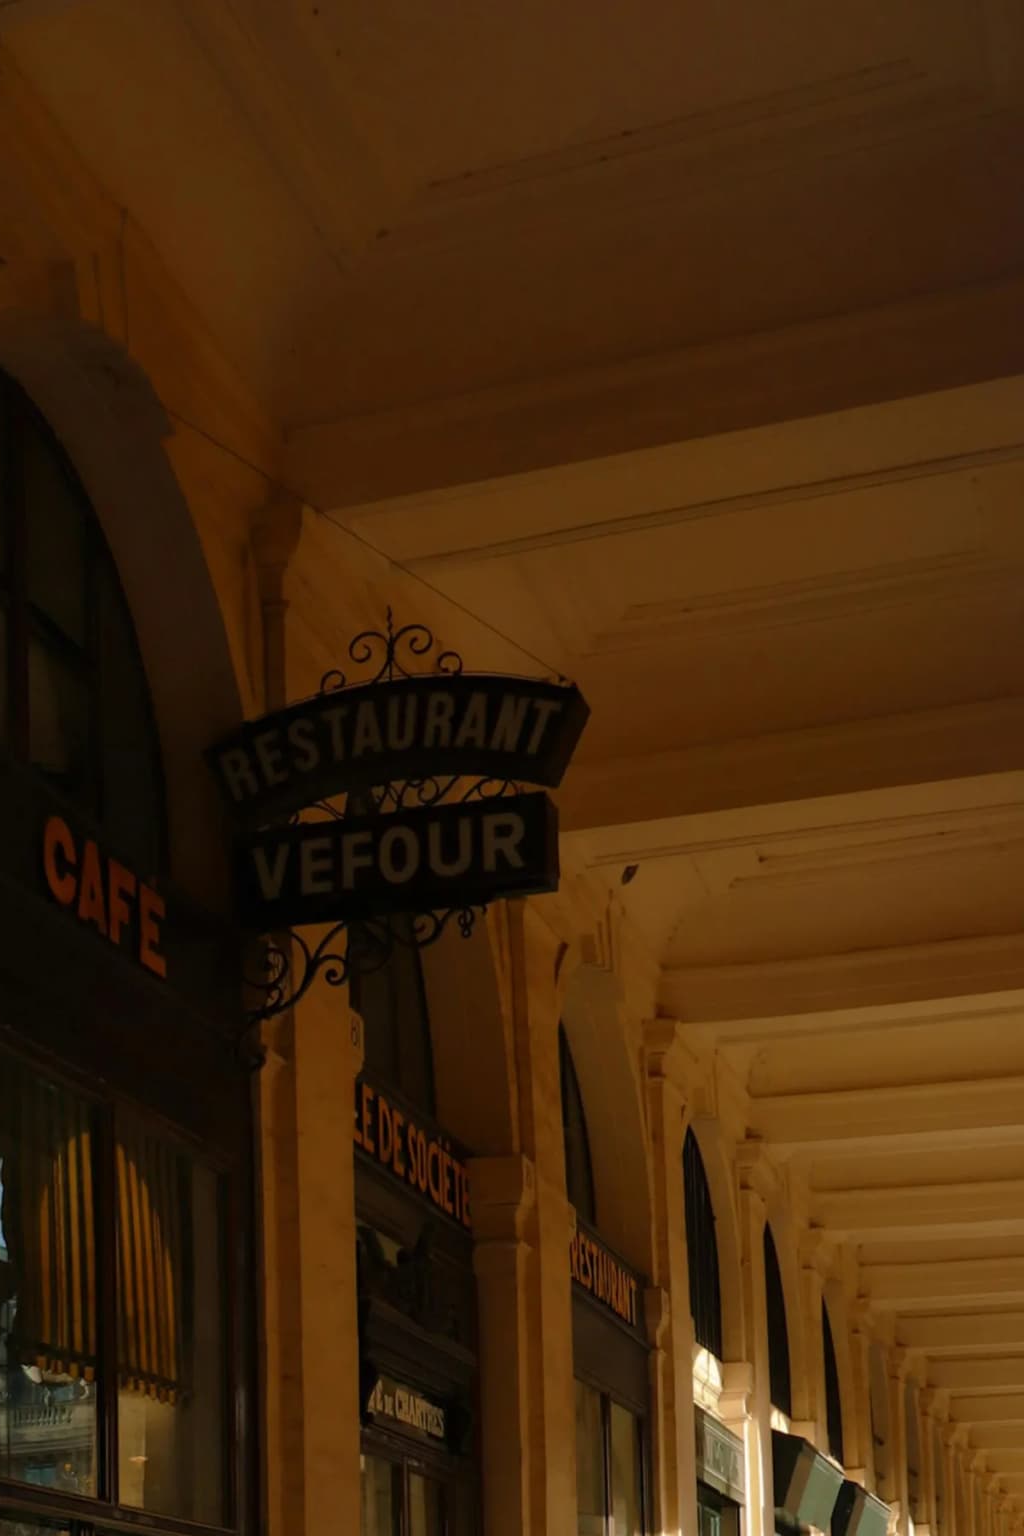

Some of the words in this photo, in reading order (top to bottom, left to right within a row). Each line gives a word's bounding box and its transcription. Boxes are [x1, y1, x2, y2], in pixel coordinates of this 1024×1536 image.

[219, 692, 566, 802] RESTAURANT
[251, 811, 526, 902] VEFOUR
[378, 1096, 405, 1177] DE
